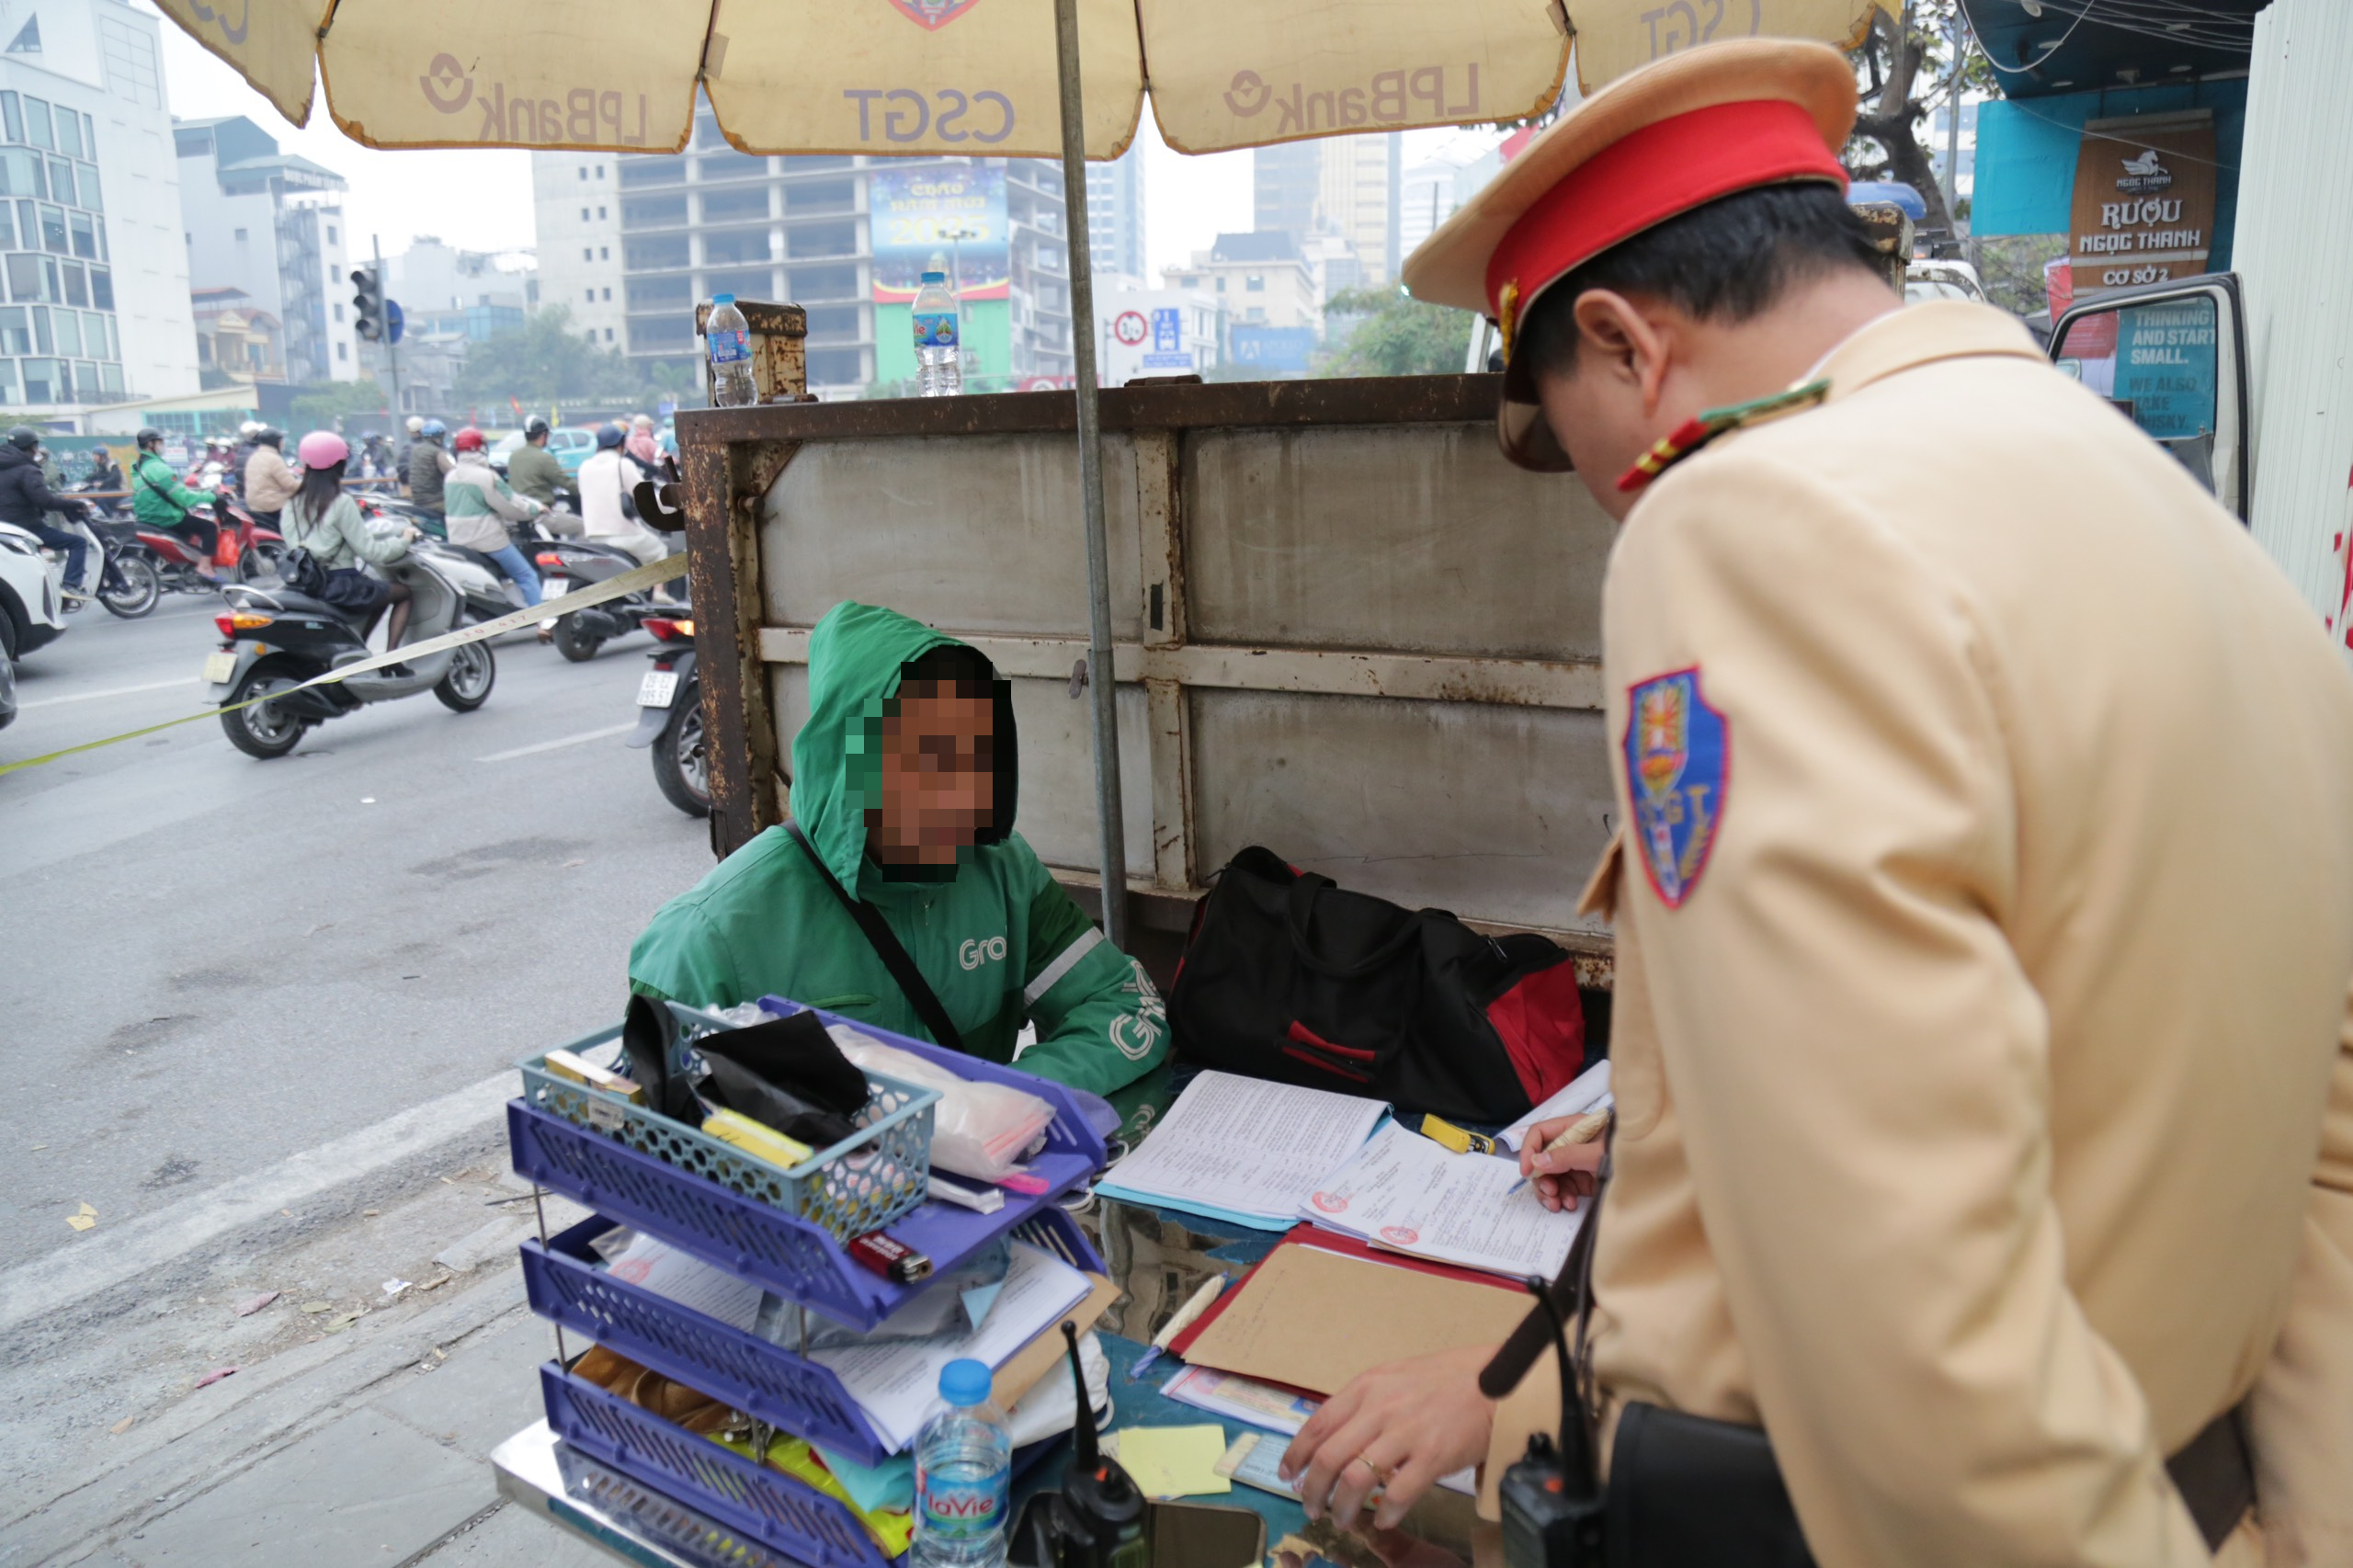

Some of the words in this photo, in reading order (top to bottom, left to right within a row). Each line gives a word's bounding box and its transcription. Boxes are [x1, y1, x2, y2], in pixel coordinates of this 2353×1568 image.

[2101, 198, 2183, 230] RƯỢU
[889, 214, 990, 245] 2025
[2079, 233, 2132, 256] NGỌC
[2137, 229, 2200, 250] THANH
[2102, 268, 2131, 286] CƠ
[2131, 265, 2157, 284] SỞ
[2158, 267, 2170, 282] 2
[2134, 309, 2210, 327] THINKING
[2131, 328, 2165, 347] AND
[2131, 348, 2189, 365] SMALL.
[2154, 376, 2198, 392] ALSO
[959, 926, 1007, 971] Gra
